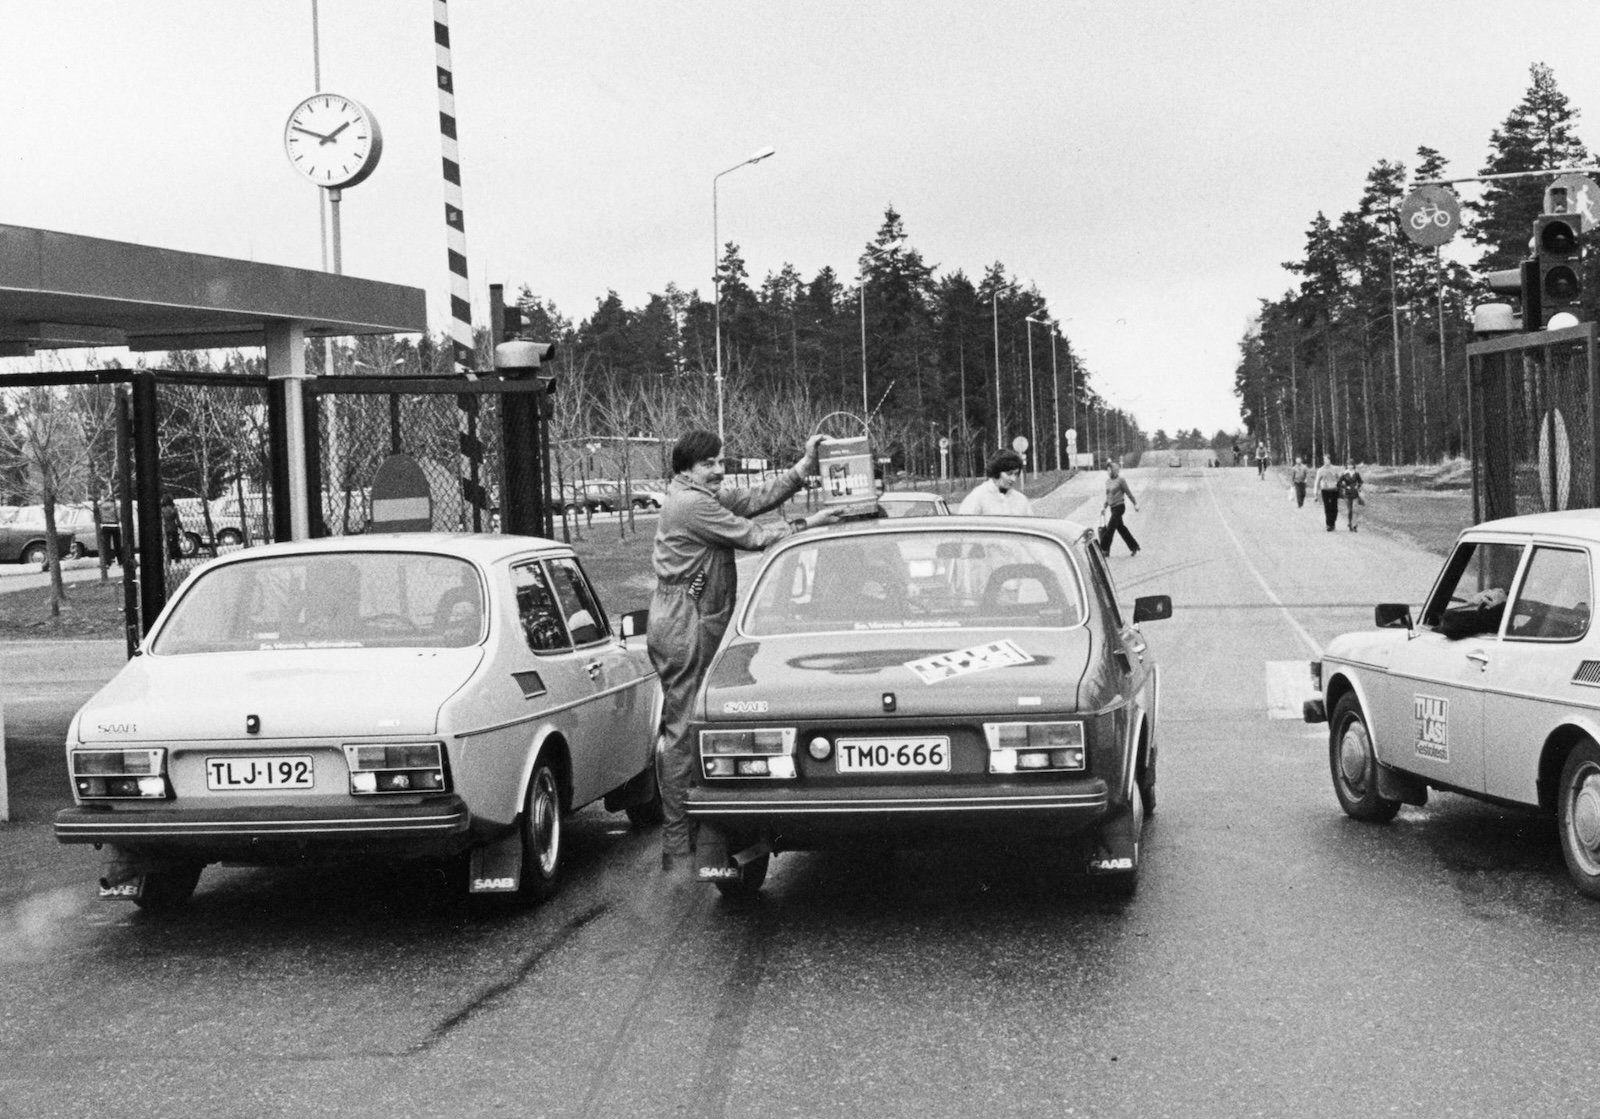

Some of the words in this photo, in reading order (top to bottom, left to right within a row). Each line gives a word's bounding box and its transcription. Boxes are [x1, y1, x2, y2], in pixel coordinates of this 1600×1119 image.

[724, 701, 768, 713] SAAB
[1415, 697, 1447, 721] TUULI
[98, 723, 137, 733] SAAB
[1423, 719, 1446, 745] LASI
[1091, 858, 1132, 869] SAAB
[699, 866, 739, 877] SAAB
[474, 877, 514, 889] SAAB
